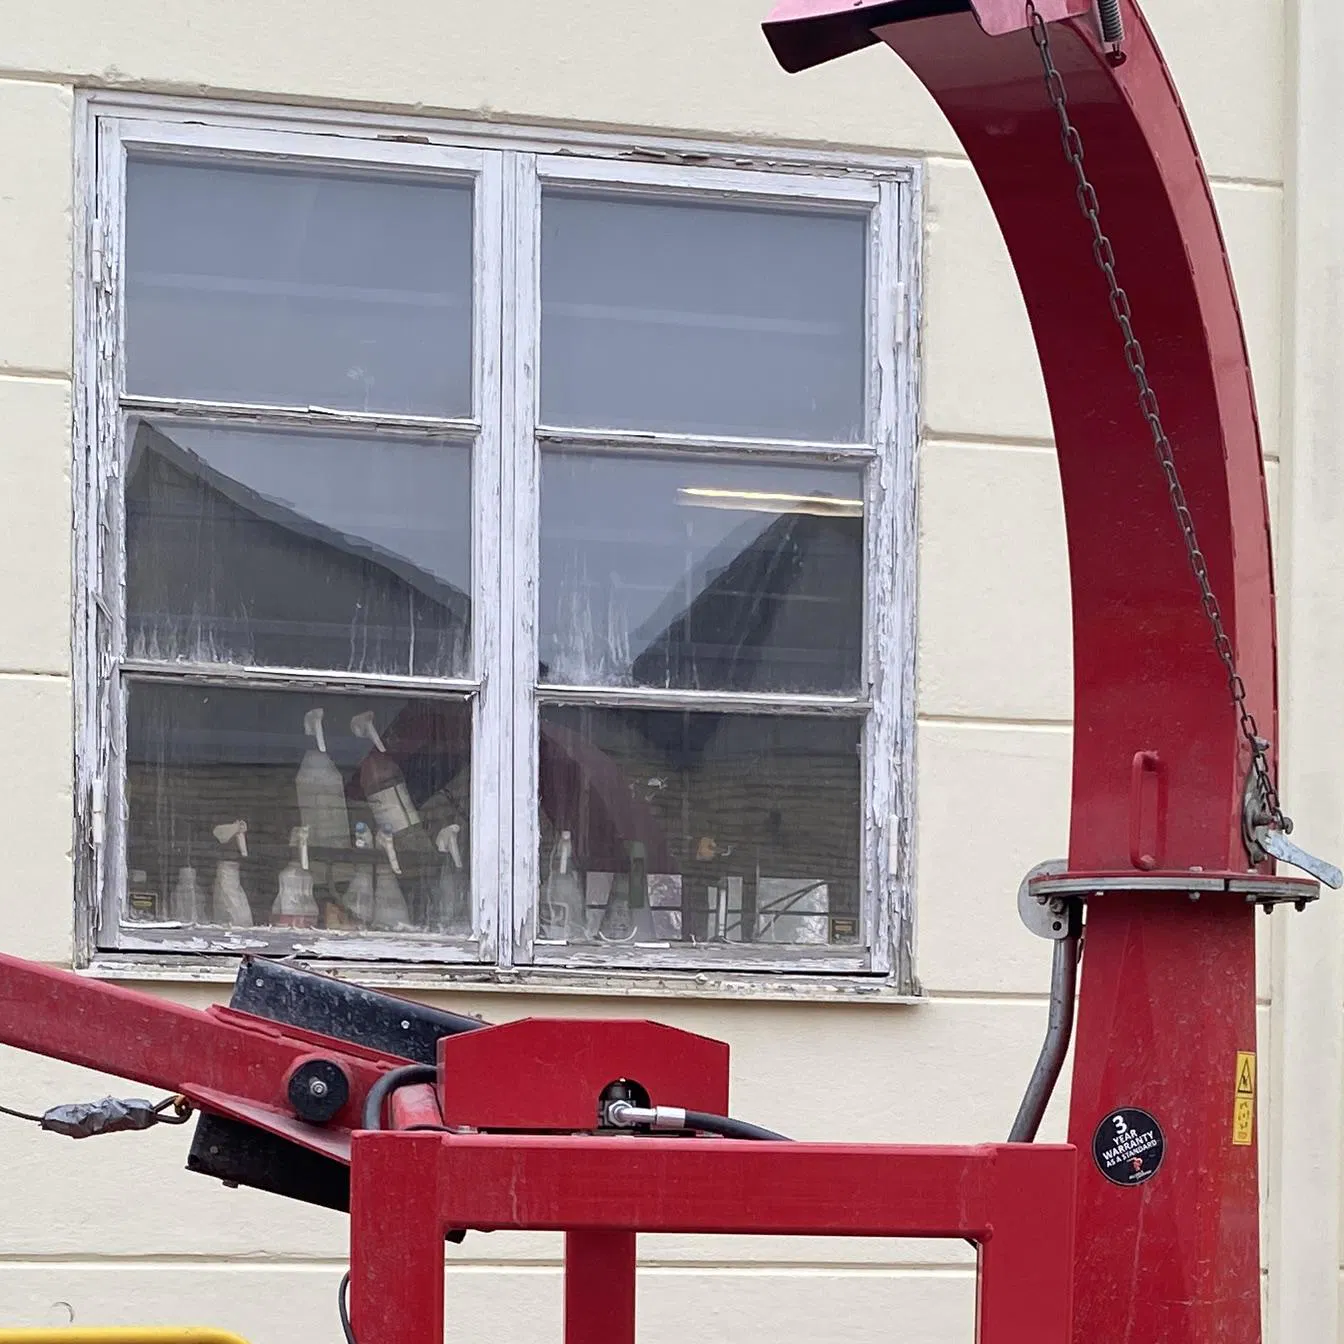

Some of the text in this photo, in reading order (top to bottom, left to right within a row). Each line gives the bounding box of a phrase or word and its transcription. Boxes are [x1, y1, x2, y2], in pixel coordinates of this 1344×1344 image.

[1112, 1115, 1127, 1134] 3
[1102, 1130, 1155, 1160] WARRANTY
[1112, 1129, 1138, 1146] YEAR
[1106, 1159, 1116, 1168] AS
[1122, 1139, 1158, 1159] STANDARD
